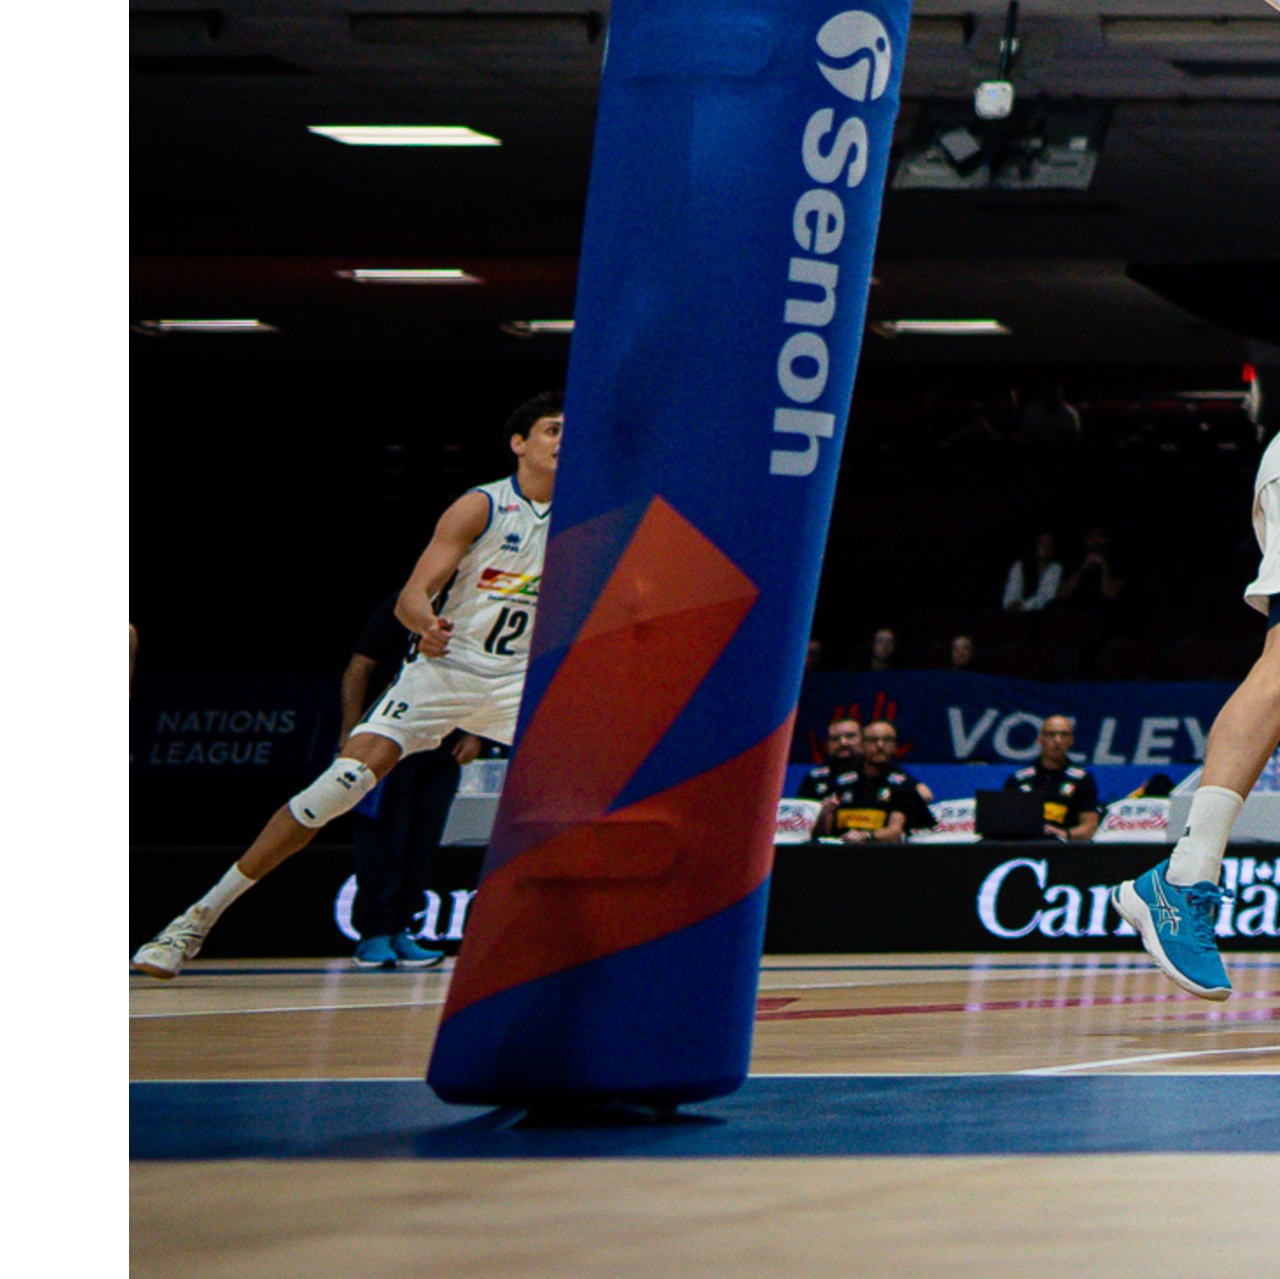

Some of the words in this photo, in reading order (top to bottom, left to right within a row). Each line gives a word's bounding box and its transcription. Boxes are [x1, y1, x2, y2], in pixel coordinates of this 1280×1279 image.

[769, 107, 869, 478] Senoh
[483, 606, 529, 656] 12
[156, 708, 297, 735] NATIONS
[381, 700, 410, 720] 12
[149, 738, 274, 766] LEAGUE
